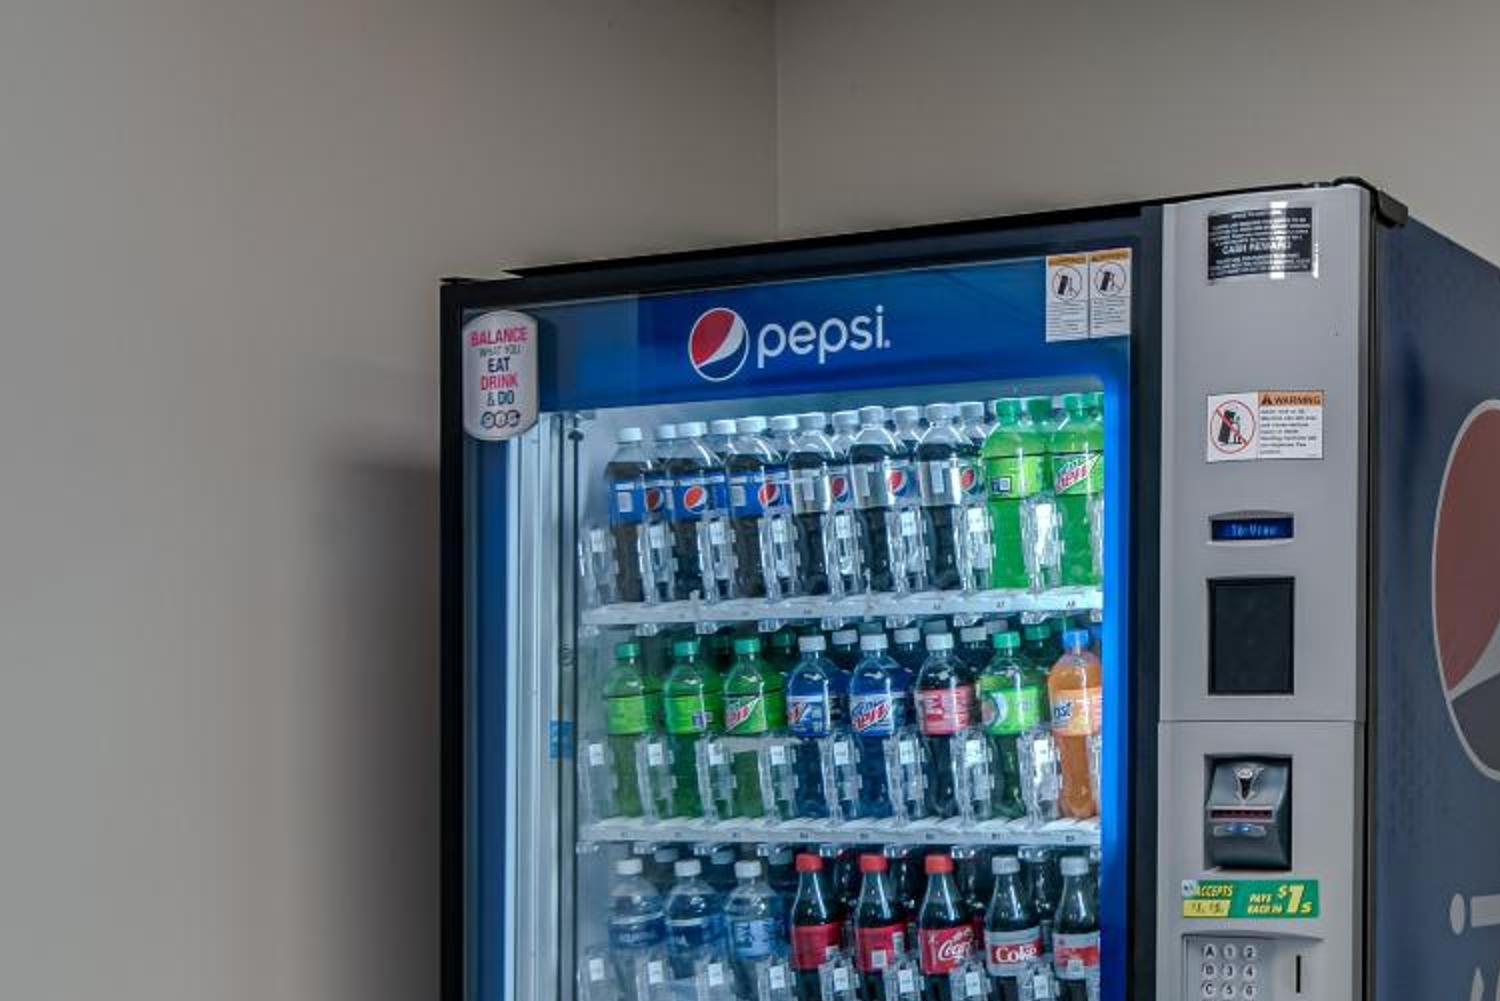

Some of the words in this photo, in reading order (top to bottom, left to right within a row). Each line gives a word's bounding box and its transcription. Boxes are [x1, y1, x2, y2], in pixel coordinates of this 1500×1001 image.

[469, 327, 528, 347] BALANCE
[757, 304, 884, 369] pepsi
[487, 356, 510, 373] EAT
[480, 373, 518, 391] DRINK
[498, 390, 514, 405] DO
[995, 945, 1039, 963] Coke
[1206, 946, 1214, 957] A
[1246, 947, 1253, 958] 2
[1205, 964, 1214, 975] B
[1227, 965, 1233, 976] 3
[1246, 966, 1253, 976] 4
[1205, 983, 1213, 995] C
[1226, 984, 1233, 995] 5
[1246, 985, 1253, 996] 6
